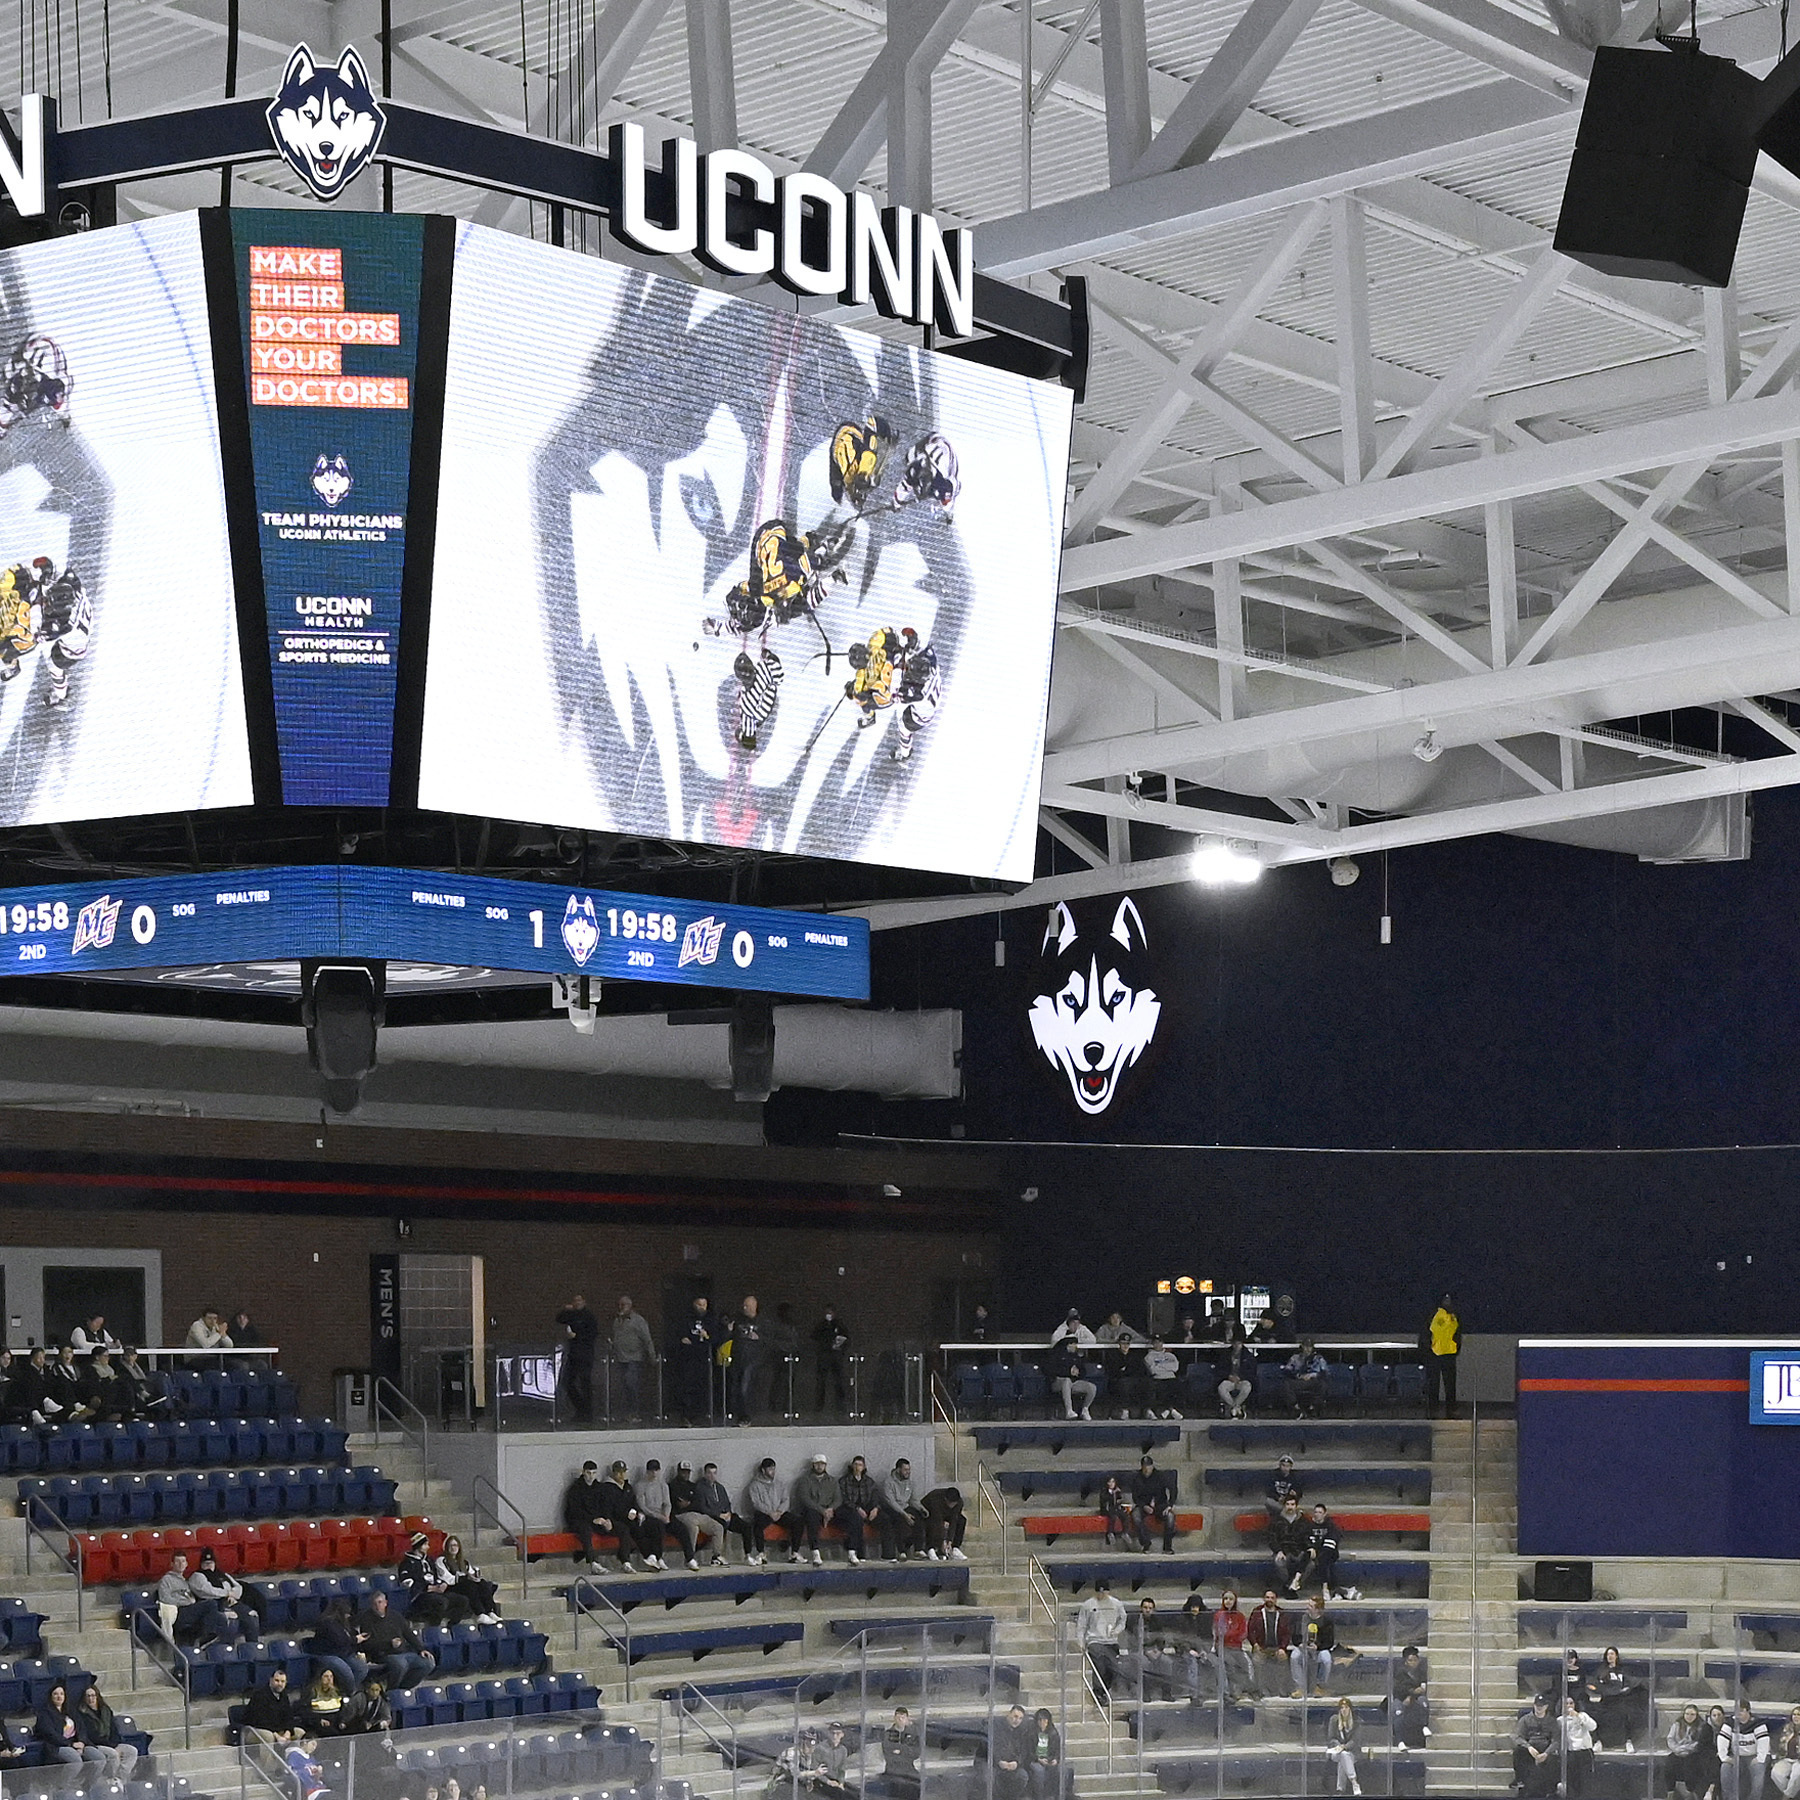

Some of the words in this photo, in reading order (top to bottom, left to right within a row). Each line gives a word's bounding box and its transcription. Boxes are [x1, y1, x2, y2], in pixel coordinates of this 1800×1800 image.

[620, 122, 973, 338] UCONN
[254, 251, 336, 275] MAKE
[253, 284, 338, 307] THEIR
[256, 316, 395, 340] DOCTORS
[256, 348, 335, 370] YOUR
[257, 380, 404, 404] DOCTORS.
[262, 513, 305, 527] TEAM
[310, 514, 402, 529] PHYSICIANS
[279, 529, 321, 540] UCONN
[323, 530, 386, 541] ATHLETICS
[296, 597, 372, 615] UCONN
[305, 617, 363, 628] HEALTH
[284, 638, 373, 650] ORTHOPEDICS
[279, 652, 327, 663] SPORTS
[330, 653, 390, 665] MEDICINE
[216, 890, 270, 905] PENALTIES
[412, 891, 466, 908] PENALTIES
[172, 904, 196, 917] SOG
[485, 906, 509, 921] SOG
[131, 905, 156, 945] 0
[528, 910, 544, 948] 1
[606, 908, 678, 942] 19:58
[768, 935, 788, 948] SOG
[804, 932, 848, 947] PENALTIES
[18, 944, 47, 960] 2ND
[731, 930, 754, 969] 0
[627, 950, 655, 968] 2ND
[379, 1268, 394, 1339] MEN'S
